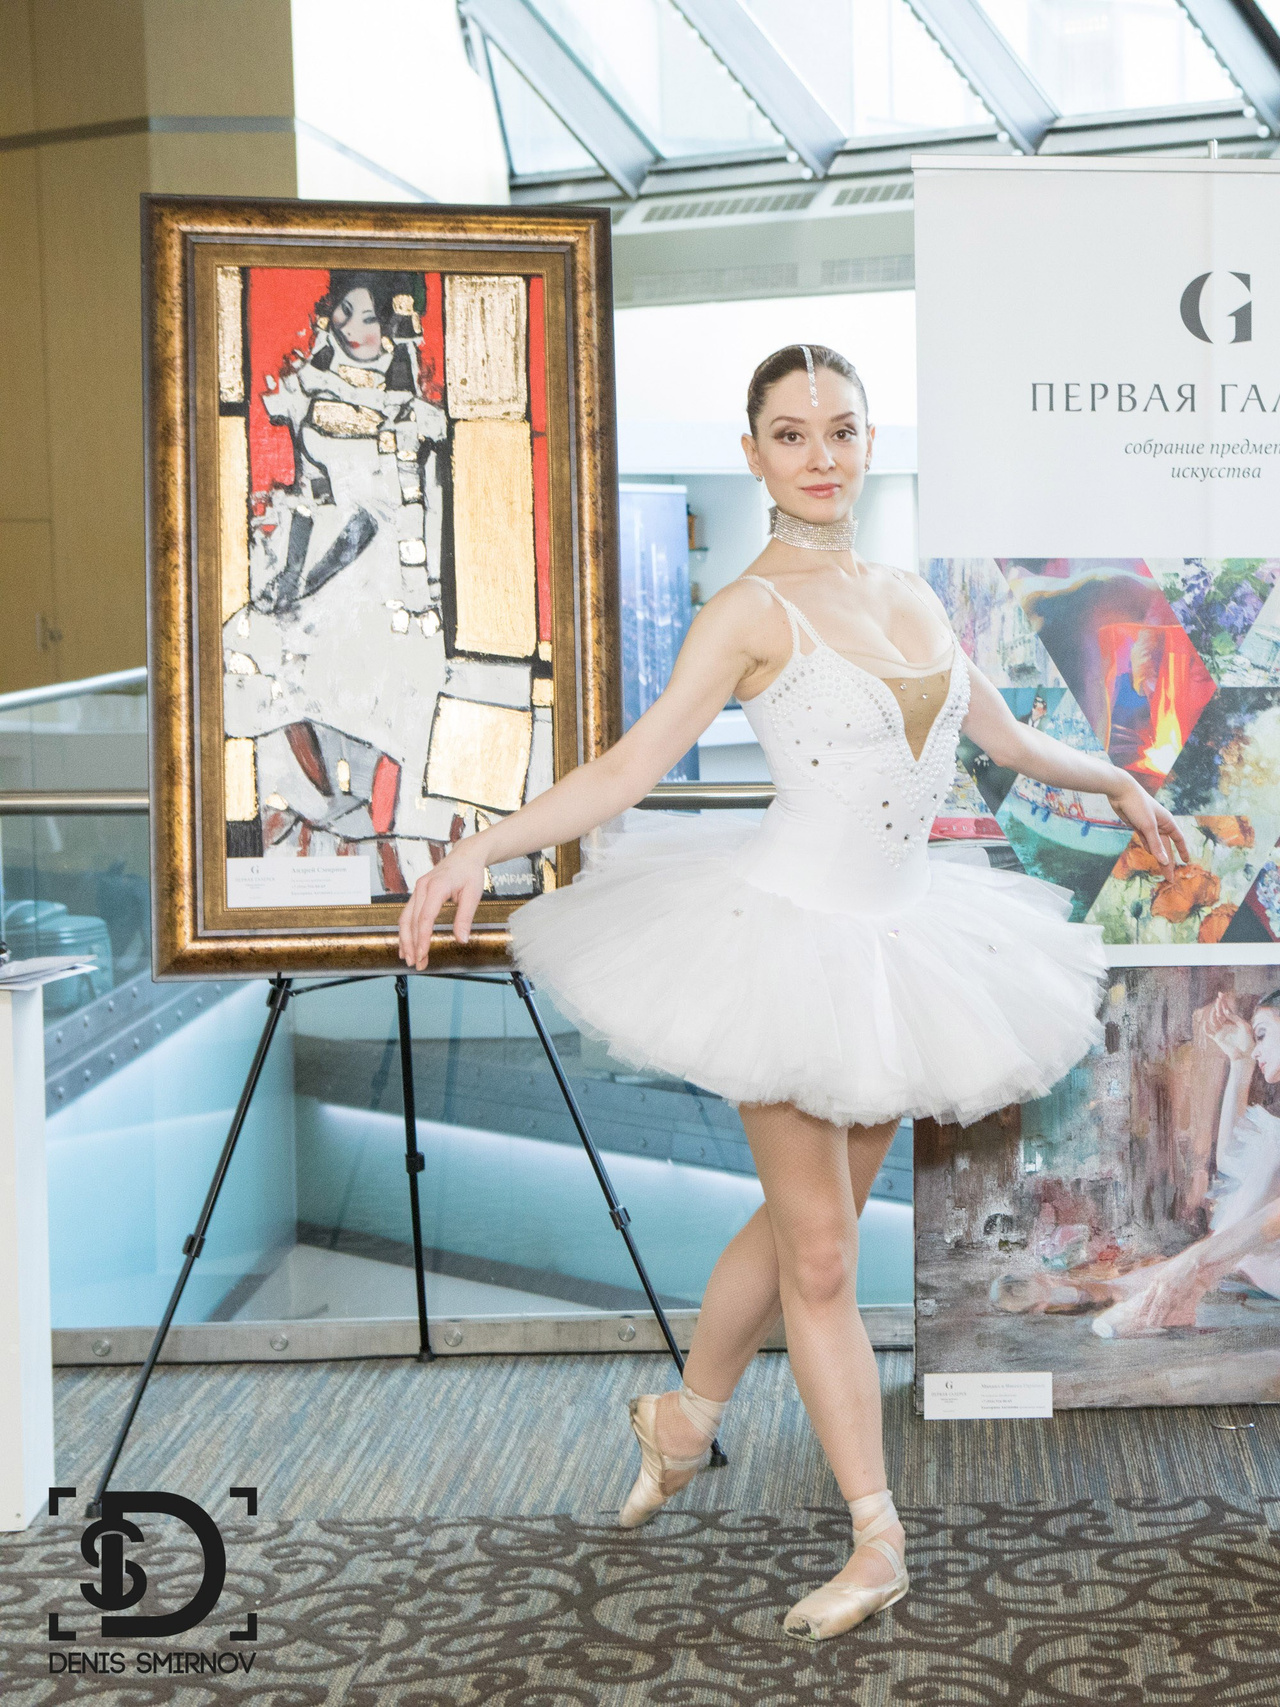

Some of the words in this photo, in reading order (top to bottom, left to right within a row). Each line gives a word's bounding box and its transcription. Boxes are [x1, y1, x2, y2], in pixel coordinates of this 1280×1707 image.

[1180, 270, 1252, 345] G
[1031, 382, 1196, 413] ПЕРВАЯ
[1124, 439, 1205, 458] собрание
[1171, 465, 1262, 482] искусства
